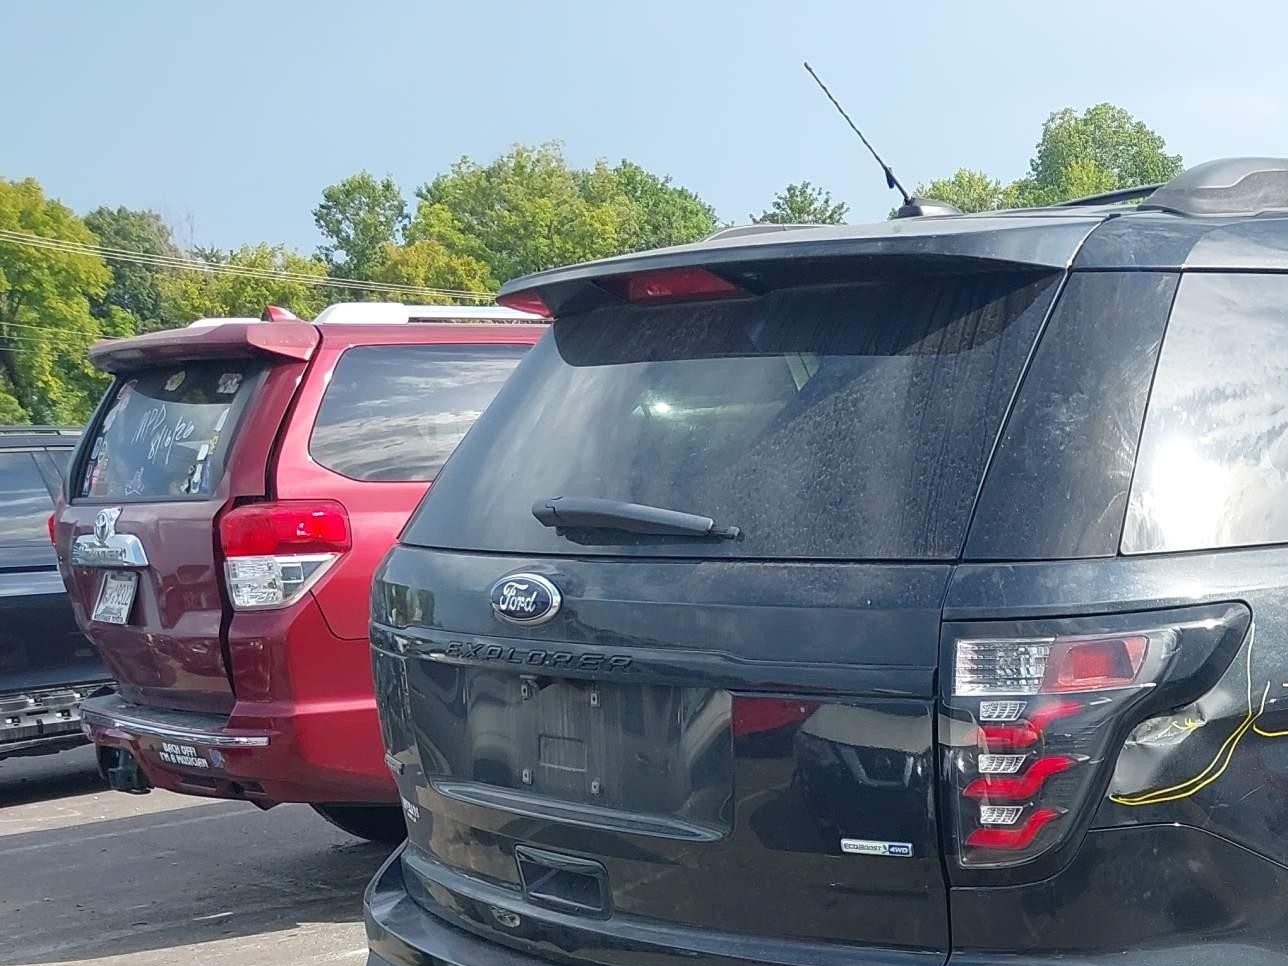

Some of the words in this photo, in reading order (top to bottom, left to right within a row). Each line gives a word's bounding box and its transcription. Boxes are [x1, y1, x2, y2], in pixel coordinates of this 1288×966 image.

[500, 581, 537, 613] Ford
[446, 641, 633, 673] EXPLORER
[889, 846, 909, 854] 4WD
